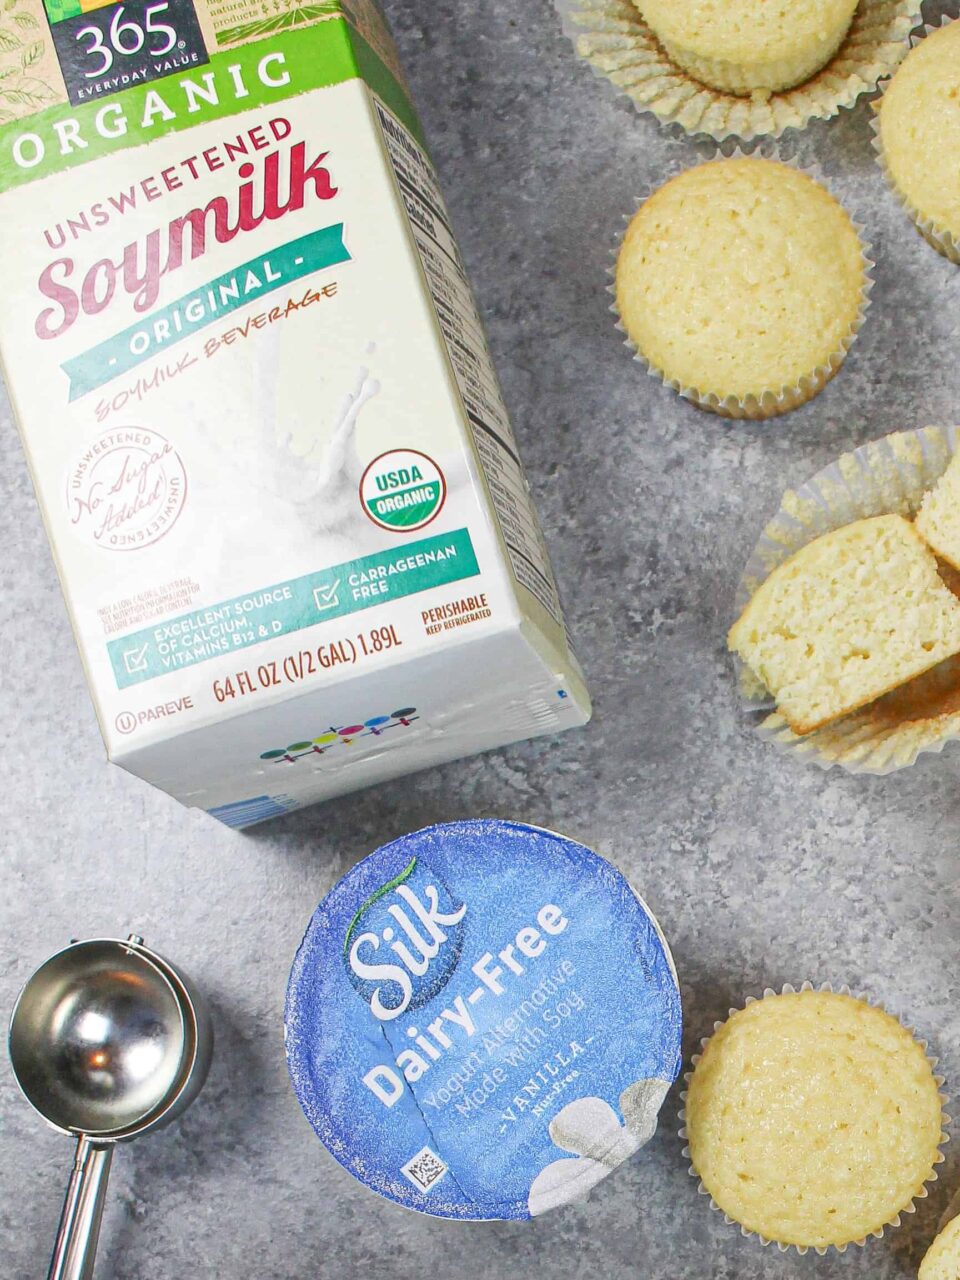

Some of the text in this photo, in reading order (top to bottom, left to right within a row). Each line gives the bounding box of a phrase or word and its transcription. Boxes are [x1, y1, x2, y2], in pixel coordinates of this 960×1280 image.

[76, 2, 178, 78] 365
[213, 9, 259, 29] products
[77, 53, 199, 99] EVERYDAY VALUE
[12, 53, 291, 168] ORGANIC
[44, 118, 292, 250] UNSWEETENED
[34, 140, 339, 341] Soymilk
[129, 261, 282, 355] ORIGINAL
[95, 353, 198, 422] SOYMILK
[204, 282, 337, 358] BEVERAGE
[71, 443, 173, 524] No Sugar
[73, 433, 151, 488] UNSWEETENED
[375, 465, 423, 492] USDA
[110, 477, 179, 544] UNSWEETENED
[376, 485, 435, 516] ORGANIC
[348, 545, 457, 587] CARRAGEENAN
[351, 580, 389, 601] FREE
[154, 606, 231, 642] EXCELLENT
[234, 586, 293, 615] SOURCE
[421, 593, 489, 625] PERISHABLE
[425, 608, 492, 636] KEEP REFRIGERATED
[158, 640, 180, 655] OF
[161, 620, 283, 668] VITAMINS B12 & D
[213, 624, 402, 703] 64 FL OZ (1/2 GAL) 1.89L
[138, 696, 194, 725] PAREVE
[350, 884, 467, 1021] Silk
[362, 903, 569, 1108] Dairy-Free
[424, 1051, 484, 1111] Yogurt
[483, 960, 577, 1057] Alternative
[455, 1066, 508, 1118] Made
[542, 991, 585, 1030] Soy
[502, 1041, 585, 1122] VANILLA
[532, 1069, 581, 1118] Nut-Free
